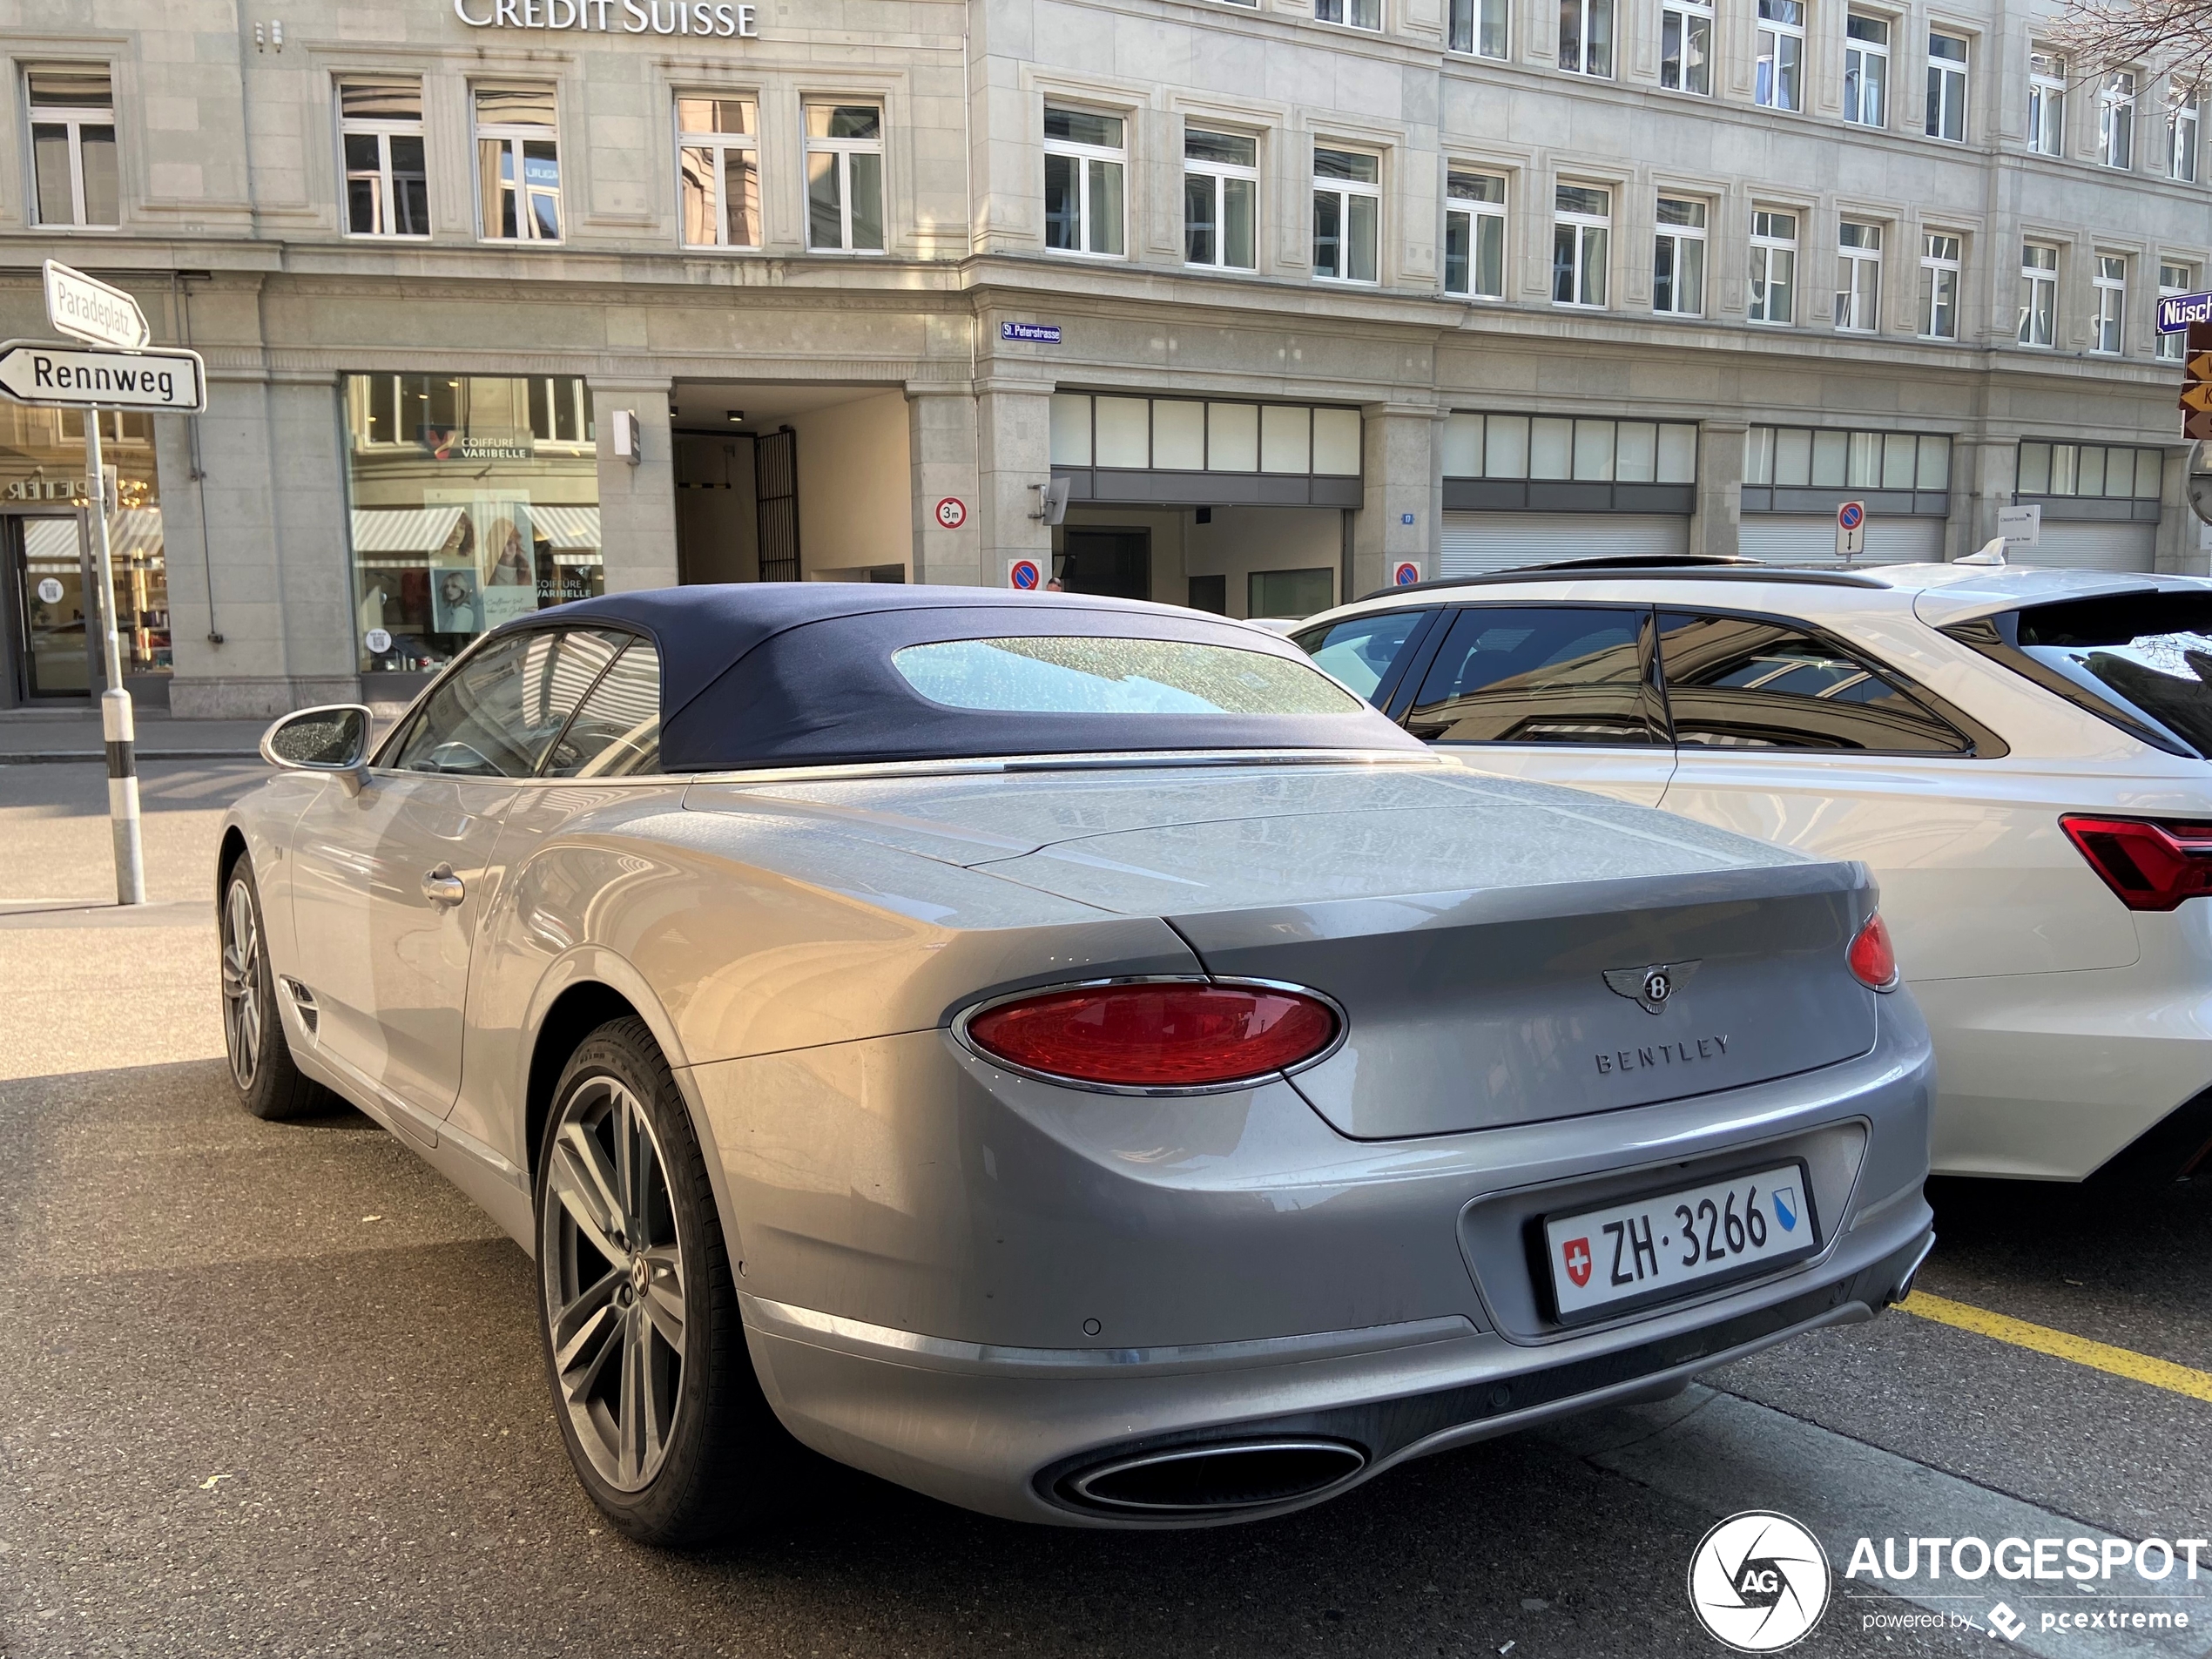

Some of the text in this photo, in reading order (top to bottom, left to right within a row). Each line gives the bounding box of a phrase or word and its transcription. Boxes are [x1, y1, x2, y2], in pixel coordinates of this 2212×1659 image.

[455, 0, 758, 37] CREDIT SUISSE
[57, 280, 130, 337] Paradeplatz
[1004, 324, 1060, 340] St. Peterstrasse
[33, 355, 173, 401] Rennweg
[462, 438, 514, 448] COIFFURE
[462, 448, 526, 459] VARIBELLE
[1595, 1034, 1729, 1075] BENTLEY
